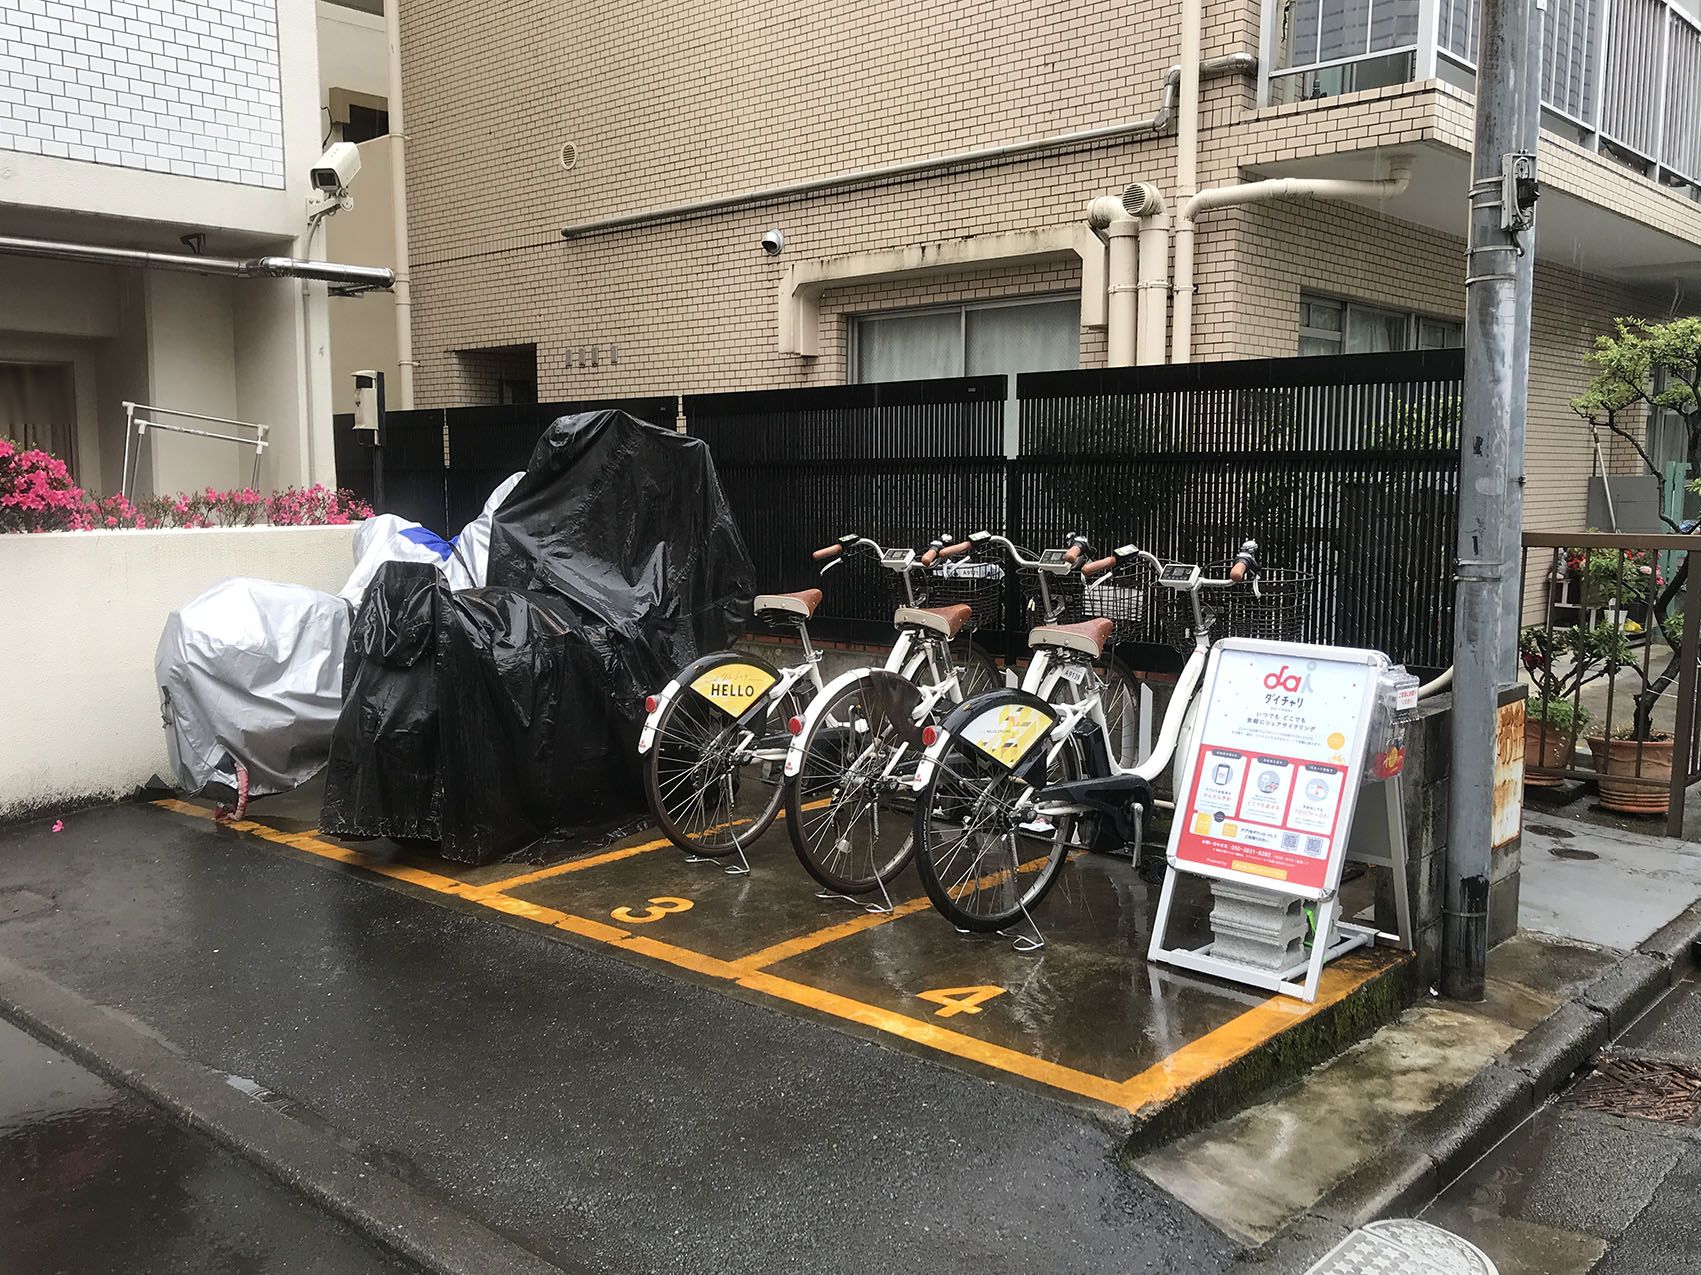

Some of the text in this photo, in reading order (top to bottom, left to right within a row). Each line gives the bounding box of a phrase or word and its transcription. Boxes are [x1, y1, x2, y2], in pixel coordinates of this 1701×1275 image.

[1263, 660, 1317, 693] dai
[711, 683, 754, 697] HELLO
[1265, 694, 1304, 708] ダイチャリ
[1256, 711, 1306, 724] いつでも どこでも
[610, 896, 695, 924] 3
[916, 984, 1007, 1018] 4
